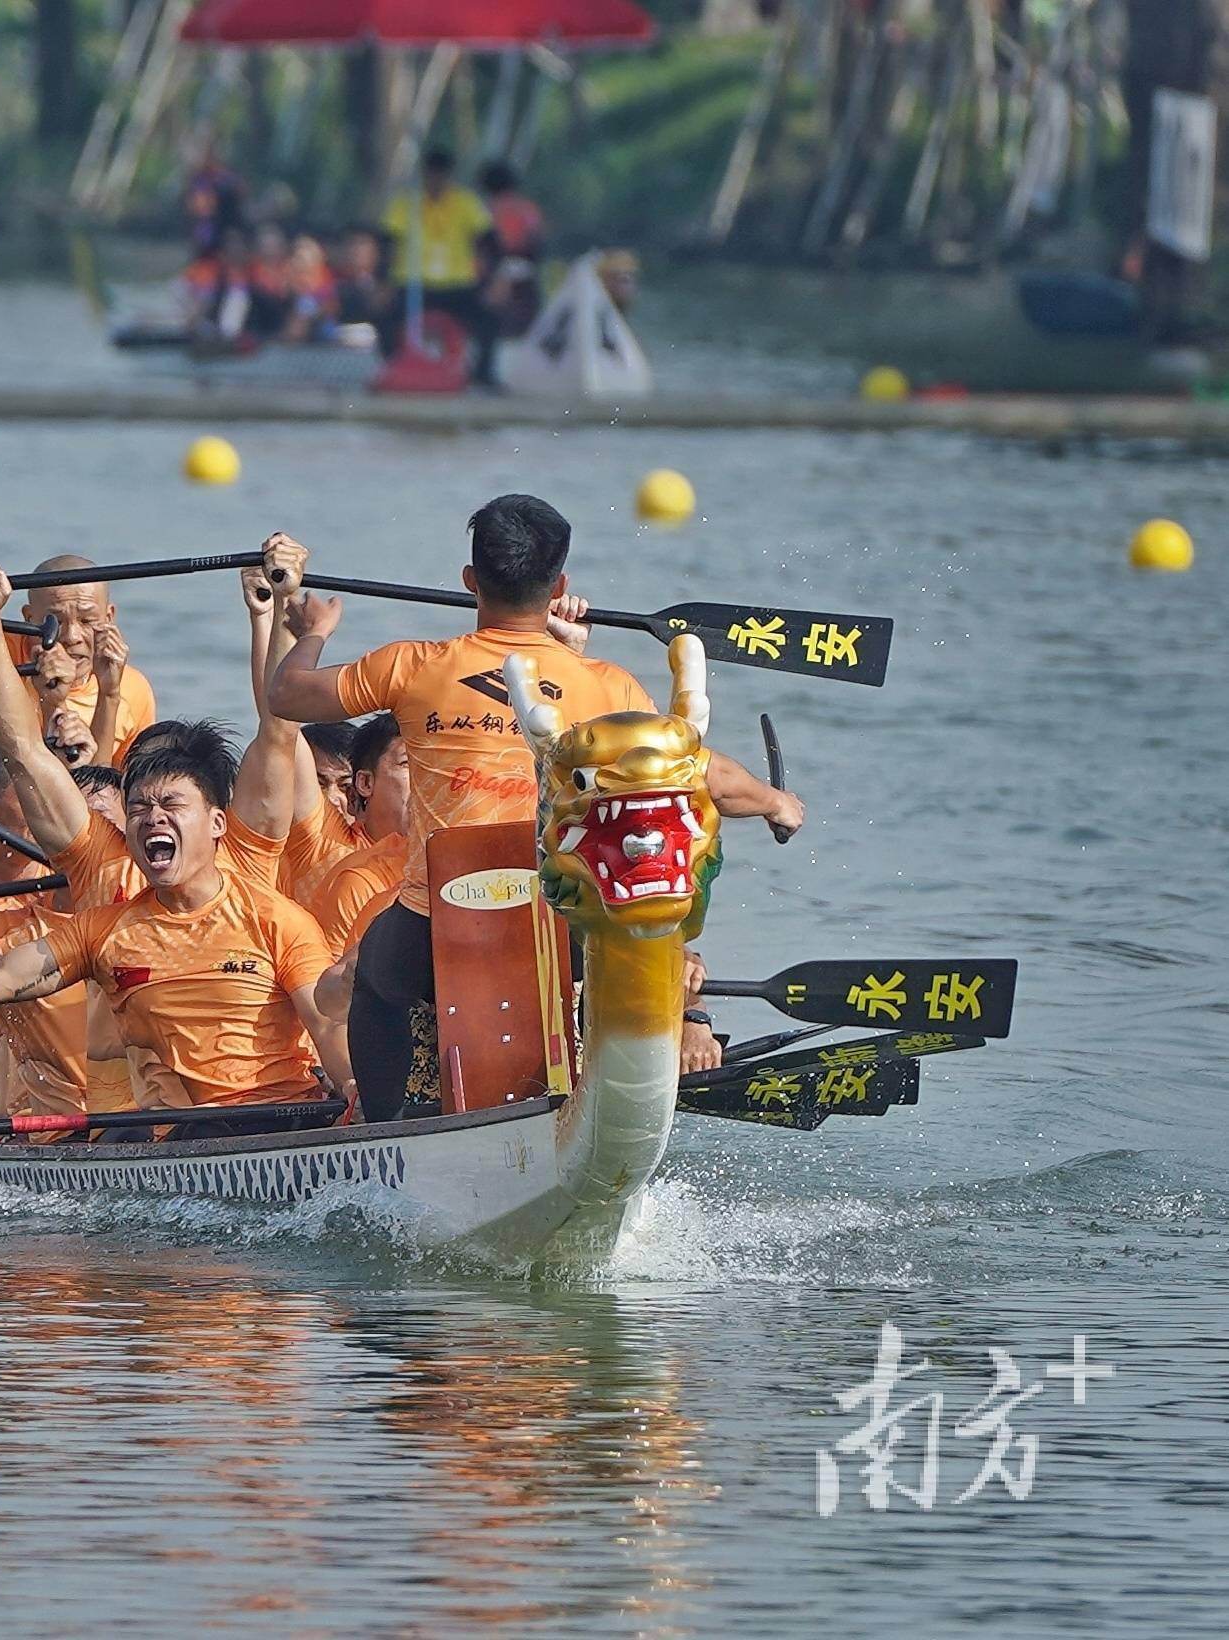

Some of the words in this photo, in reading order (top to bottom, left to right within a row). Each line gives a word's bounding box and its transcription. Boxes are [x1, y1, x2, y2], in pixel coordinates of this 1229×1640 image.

[669, 617, 686, 630] 3
[727, 616, 862, 667] 永安
[786, 984, 806, 1004] 11
[846, 970, 985, 1023] 永安
